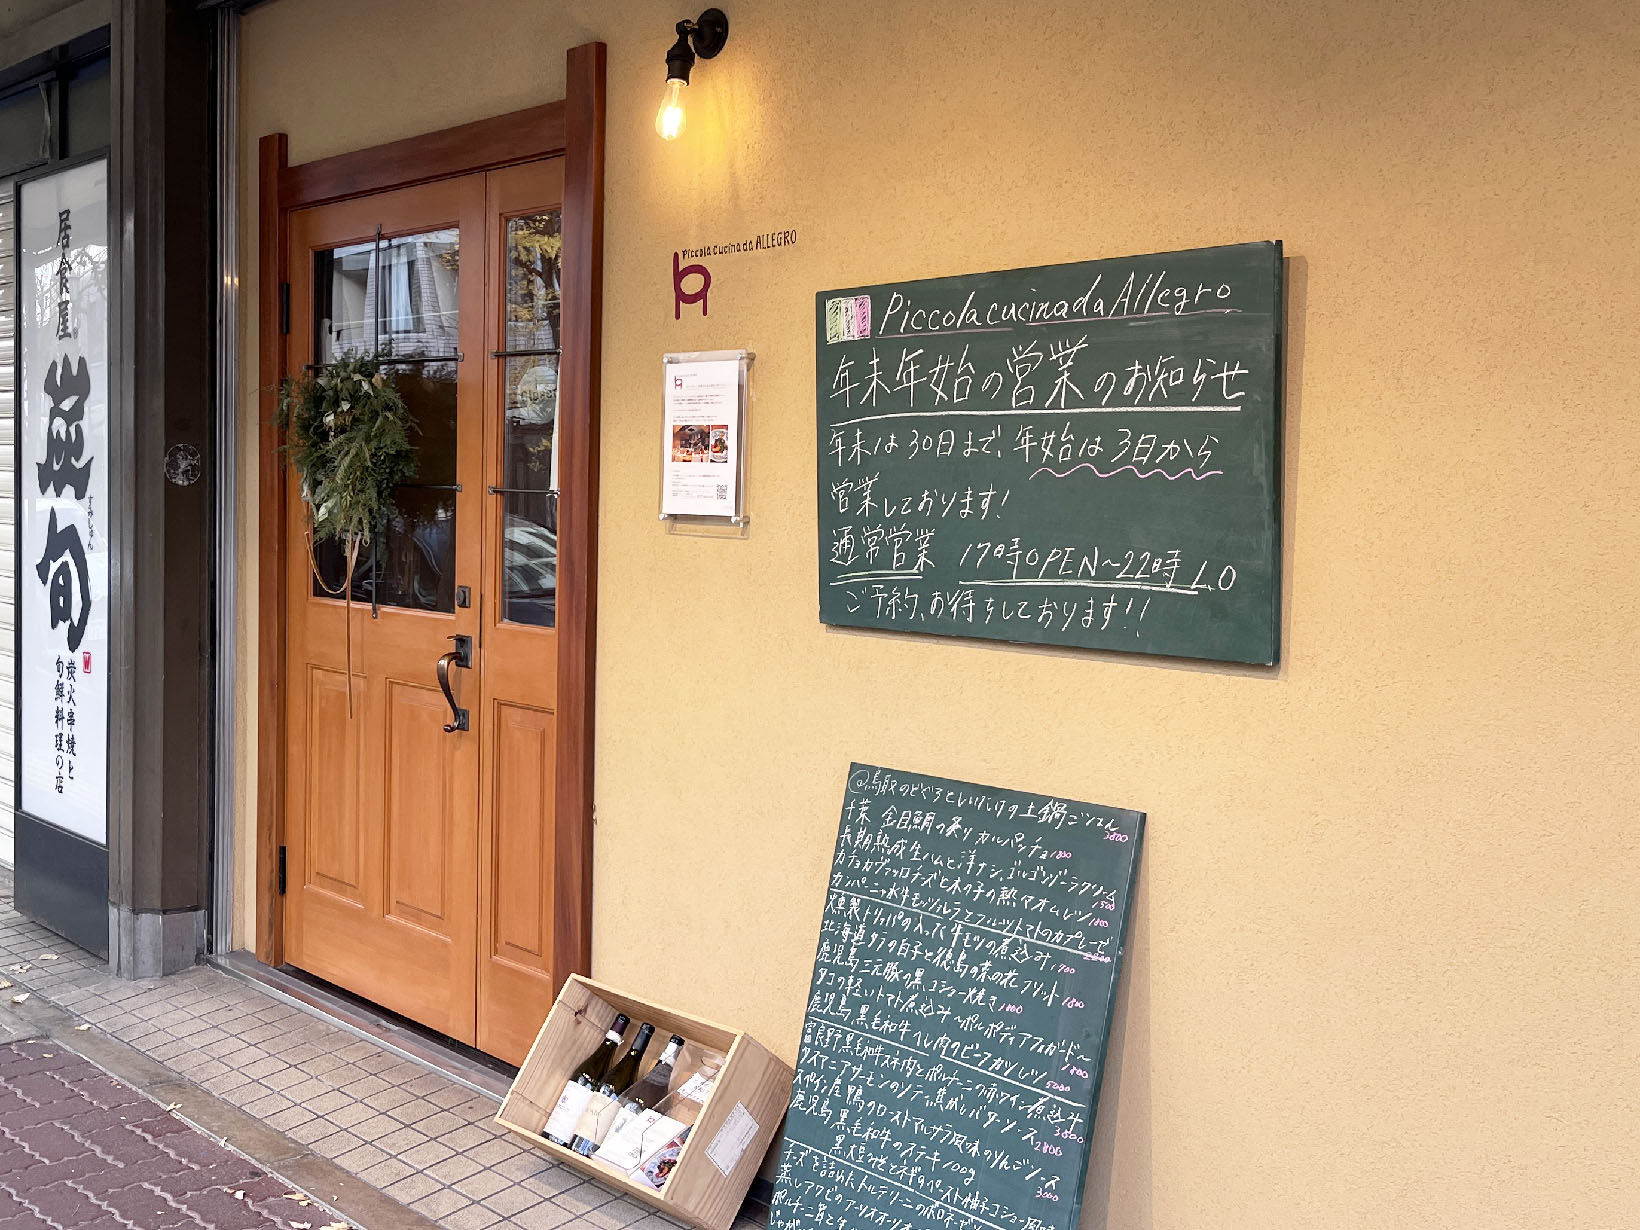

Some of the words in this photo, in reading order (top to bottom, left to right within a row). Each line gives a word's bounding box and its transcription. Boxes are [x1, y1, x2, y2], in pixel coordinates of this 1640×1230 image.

[56, 209, 72, 339] 居食屋
[756, 229, 797, 250] ALLEGRO
[829, 334, 1249, 409] 年末年始の営業のお知らせ
[829, 523, 936, 572] 通常営業
[54, 654, 66, 794] 旬鮮料理の店
[65, 659, 77, 780] 炭火串焼と
